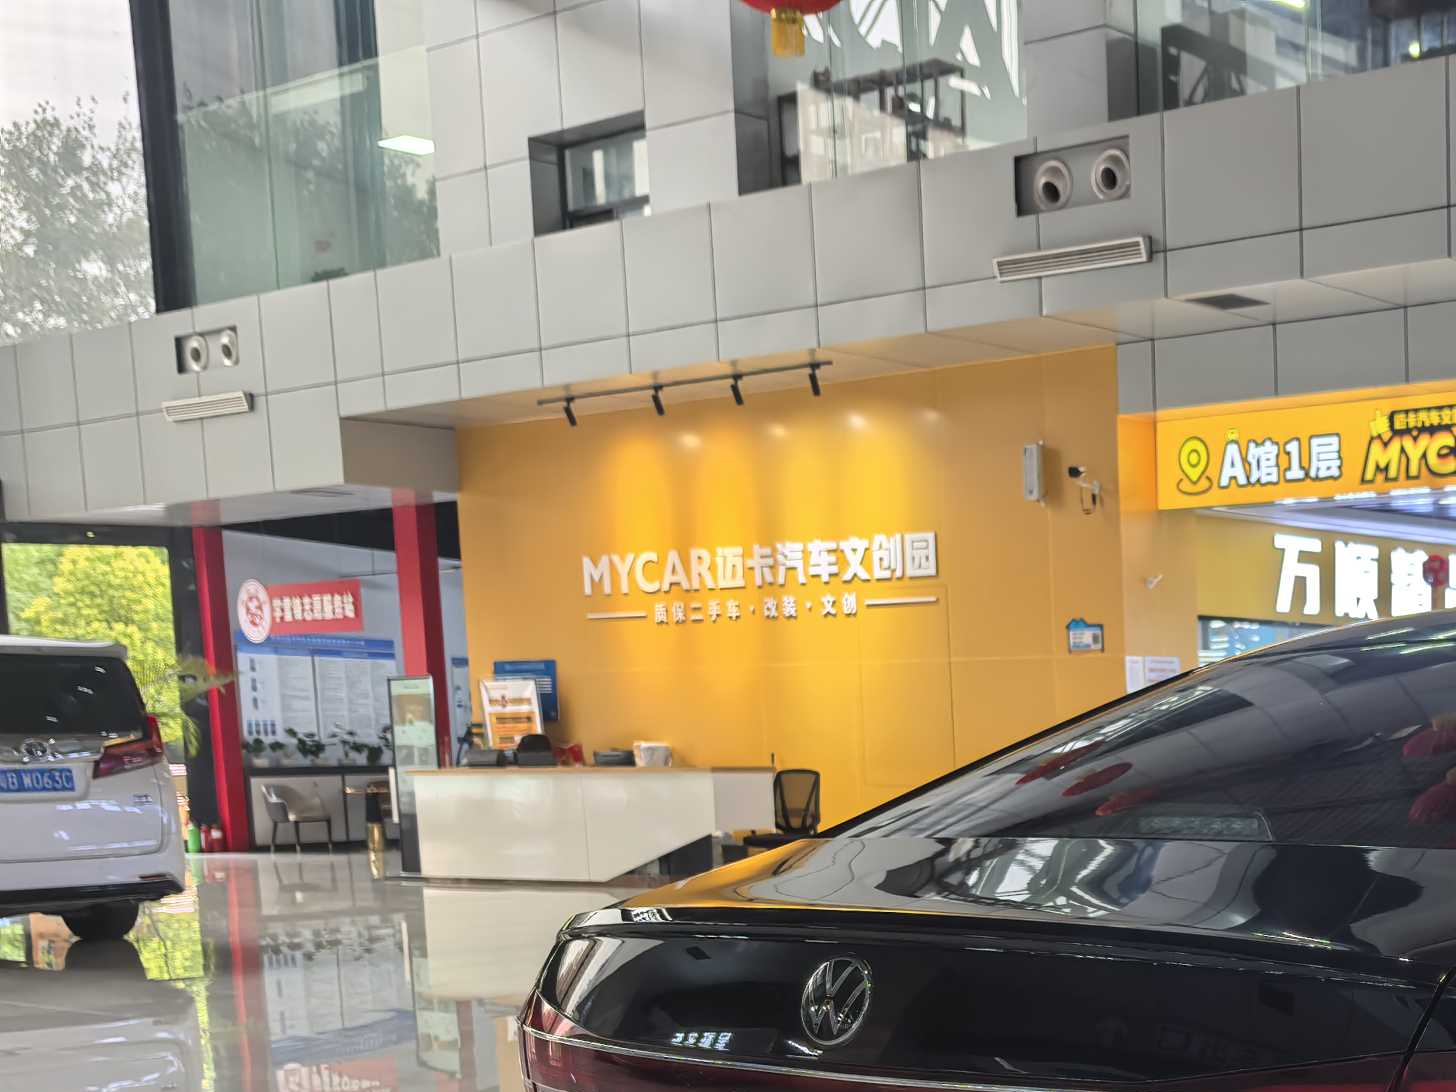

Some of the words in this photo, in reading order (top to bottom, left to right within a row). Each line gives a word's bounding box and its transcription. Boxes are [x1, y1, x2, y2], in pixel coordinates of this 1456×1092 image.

[1218, 433, 1341, 488] A馆1层
[581, 530, 938, 597] MYCAR迈卡汽车文创园
